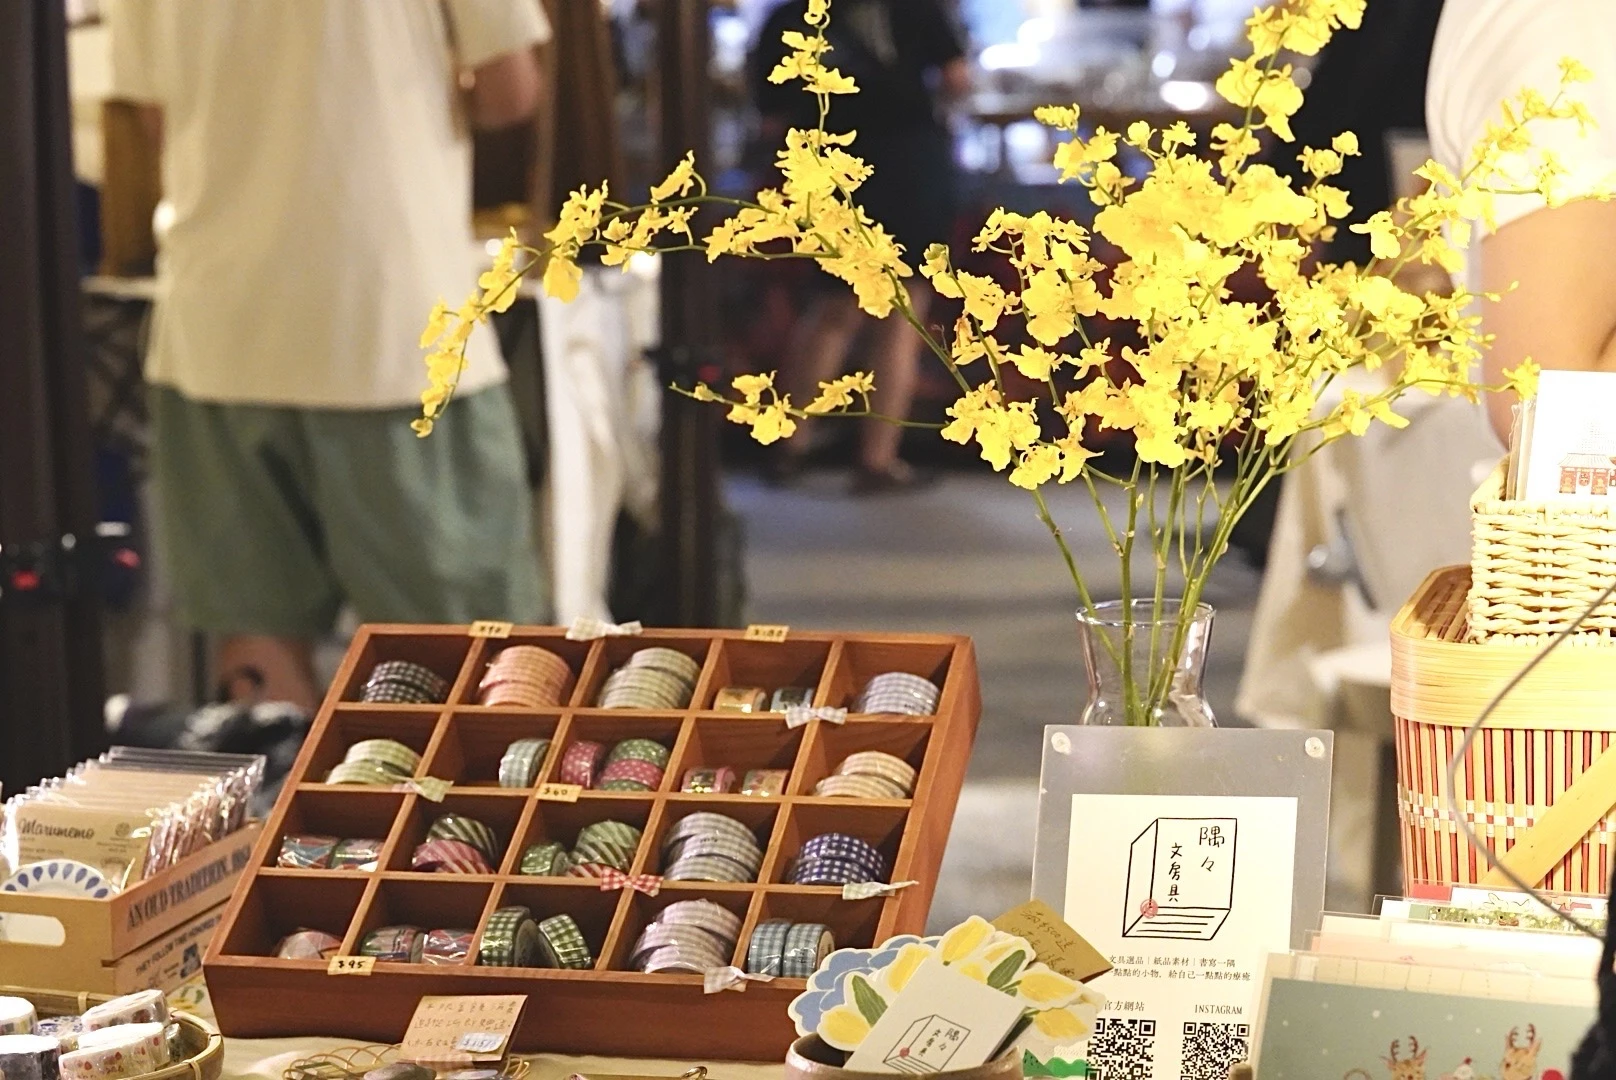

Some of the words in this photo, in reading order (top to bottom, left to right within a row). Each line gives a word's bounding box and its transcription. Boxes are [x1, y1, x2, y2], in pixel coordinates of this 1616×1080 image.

[18, 818, 95, 840] Marumemo
[1199, 826, 1225, 872] 隅々
[1168, 842, 1183, 902] 文房具
[144, 888, 168, 919] OLD
[338, 960, 366, 969] $95
[1104, 1000, 1145, 1011] 官方網站
[1194, 1004, 1243, 1015] INSTAGRAM
